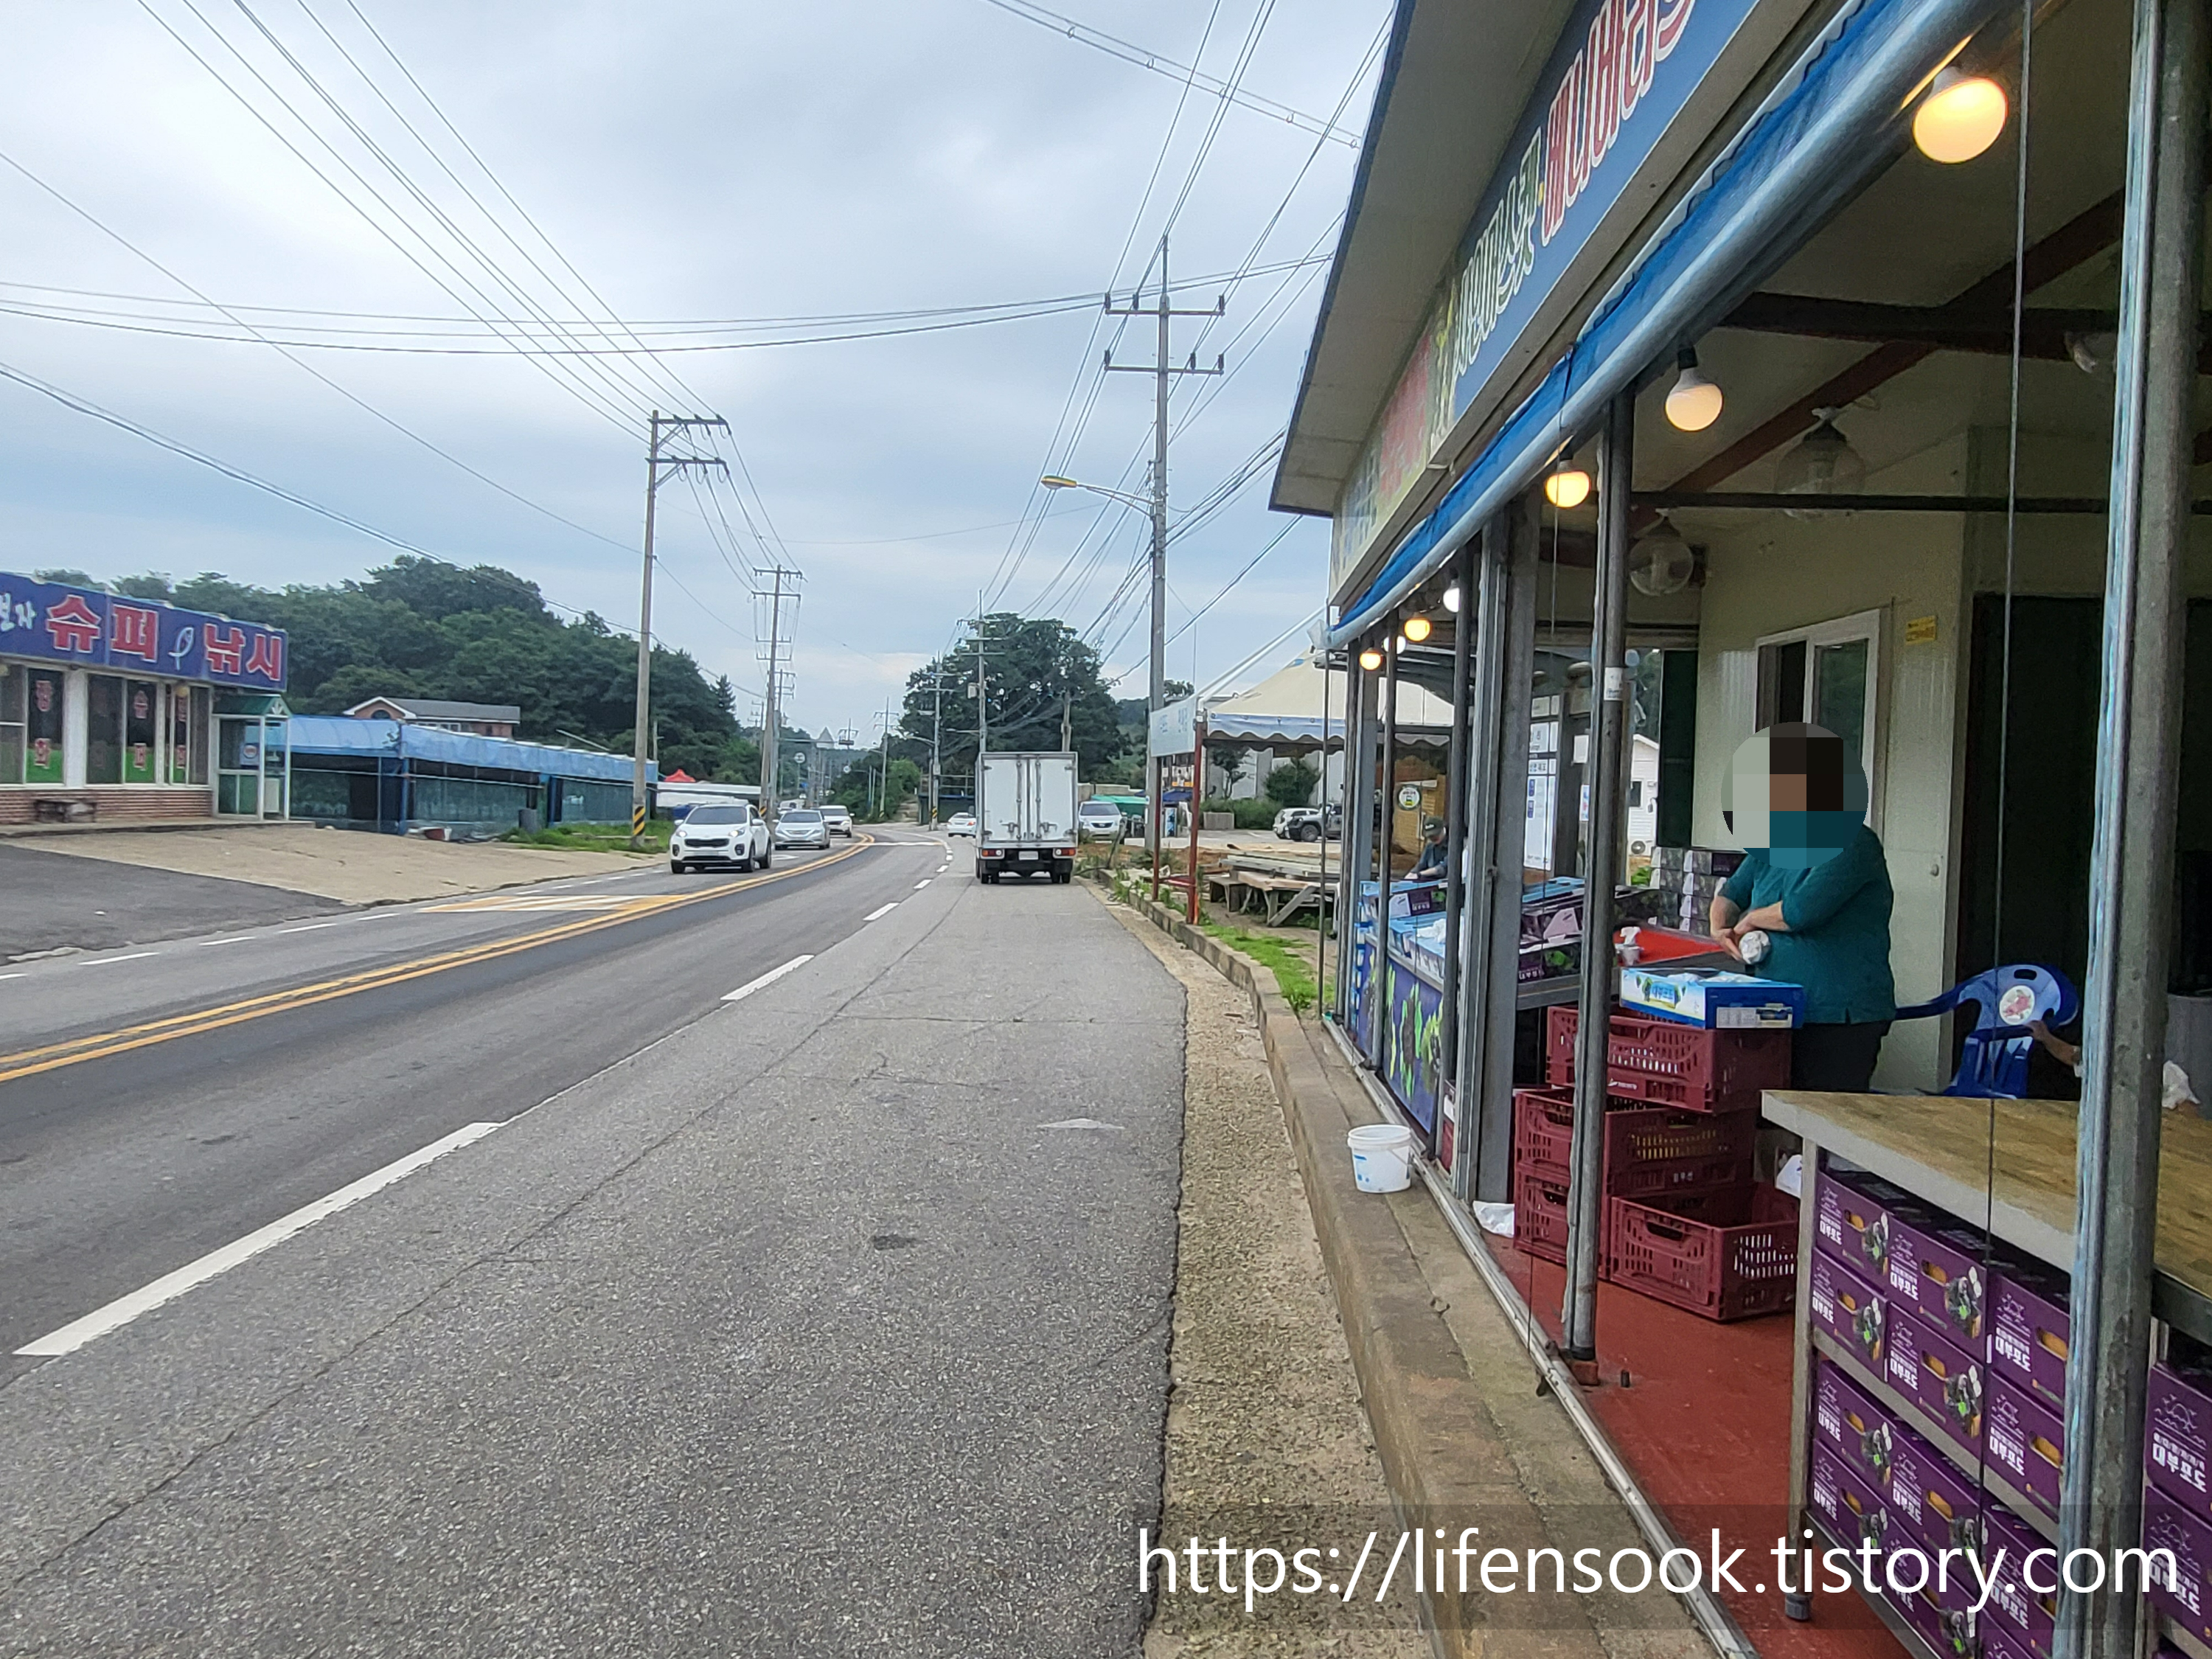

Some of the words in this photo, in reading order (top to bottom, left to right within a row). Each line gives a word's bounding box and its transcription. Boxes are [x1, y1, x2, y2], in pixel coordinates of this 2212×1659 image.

[46, 594, 158, 663] 슈퍼
[204, 623, 282, 681] 낚시
[1995, 1335, 2031, 1373] 대부포도
[1989, 1436, 2025, 1476] 대부포도
[2152, 1443, 2207, 1493] 대부포도
